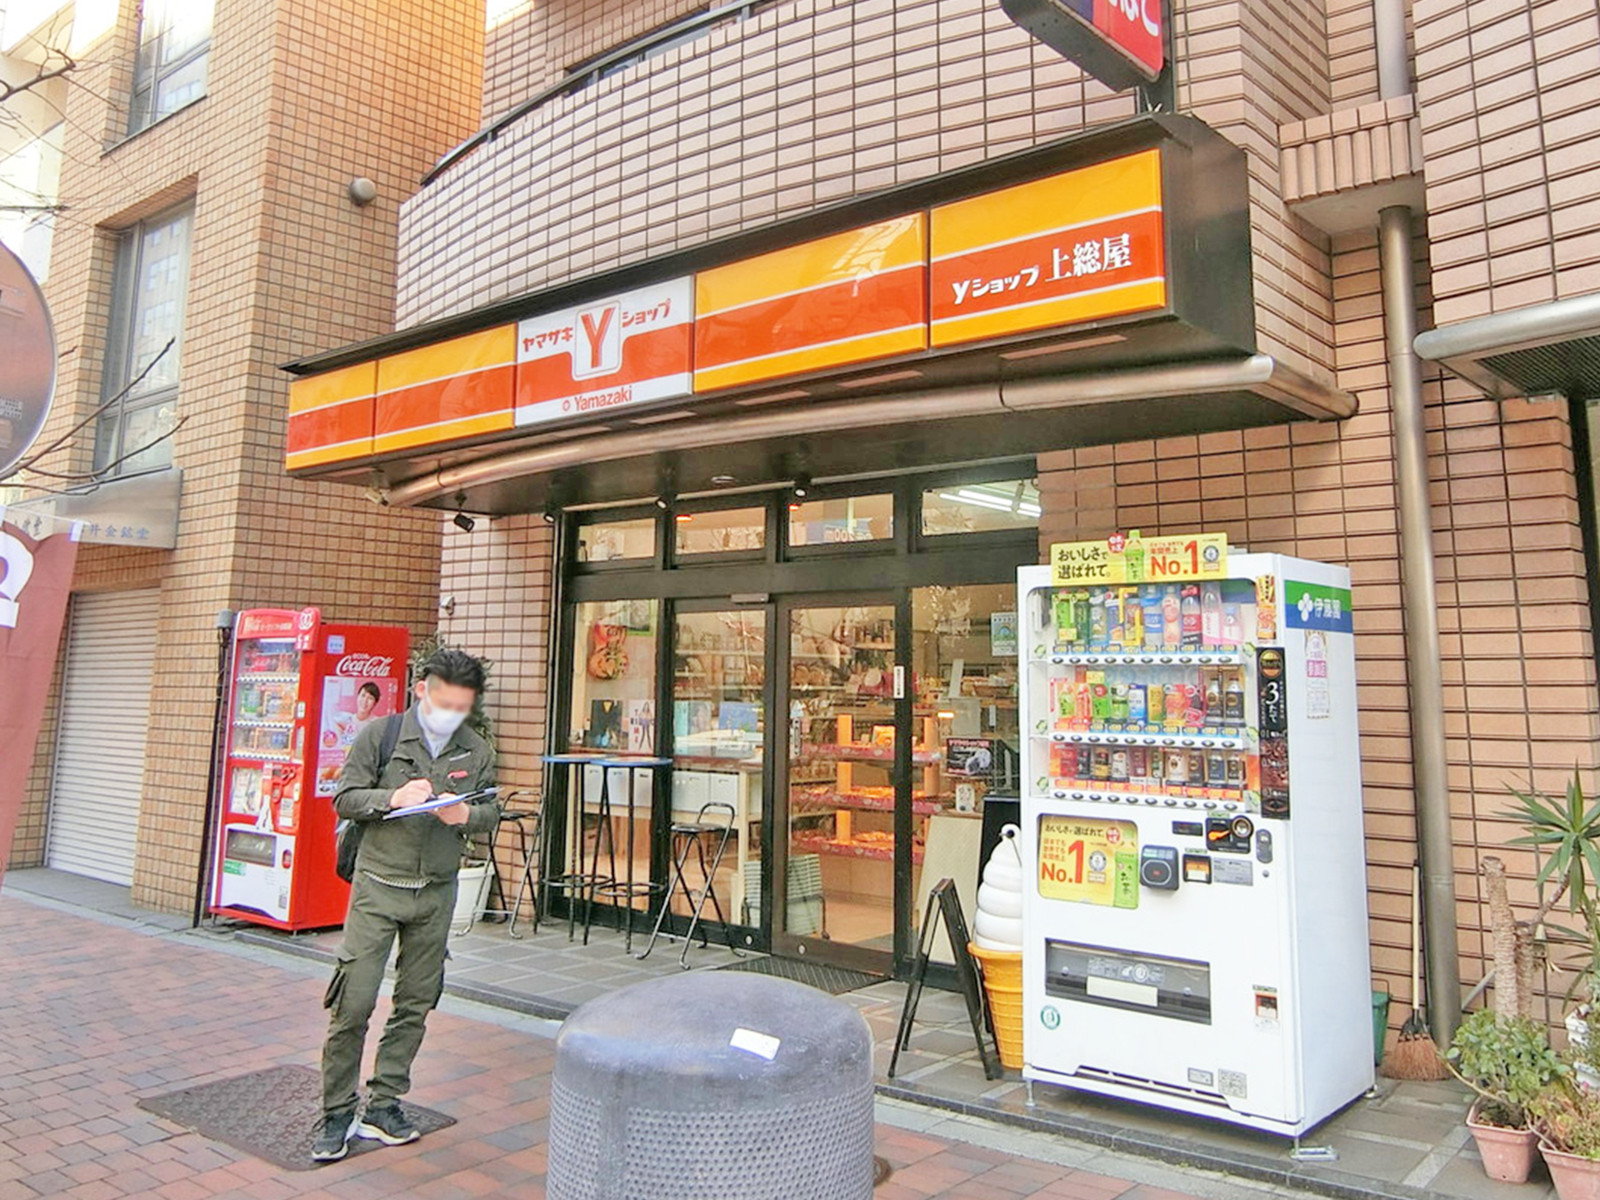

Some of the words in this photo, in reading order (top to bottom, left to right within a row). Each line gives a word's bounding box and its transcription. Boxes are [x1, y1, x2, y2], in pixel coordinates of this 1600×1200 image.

[1045, 233, 1132, 283] 上総屋
[522, 327, 574, 352] ヤマザキ
[580, 307, 616, 368] Y
[622, 298, 672, 328] ショップ
[574, 385, 633, 411] Yamazaki
[1058, 546, 1108, 561] おいしさで
[1150, 540, 1198, 577] No.1
[1041, 839, 1084, 884] No.1
